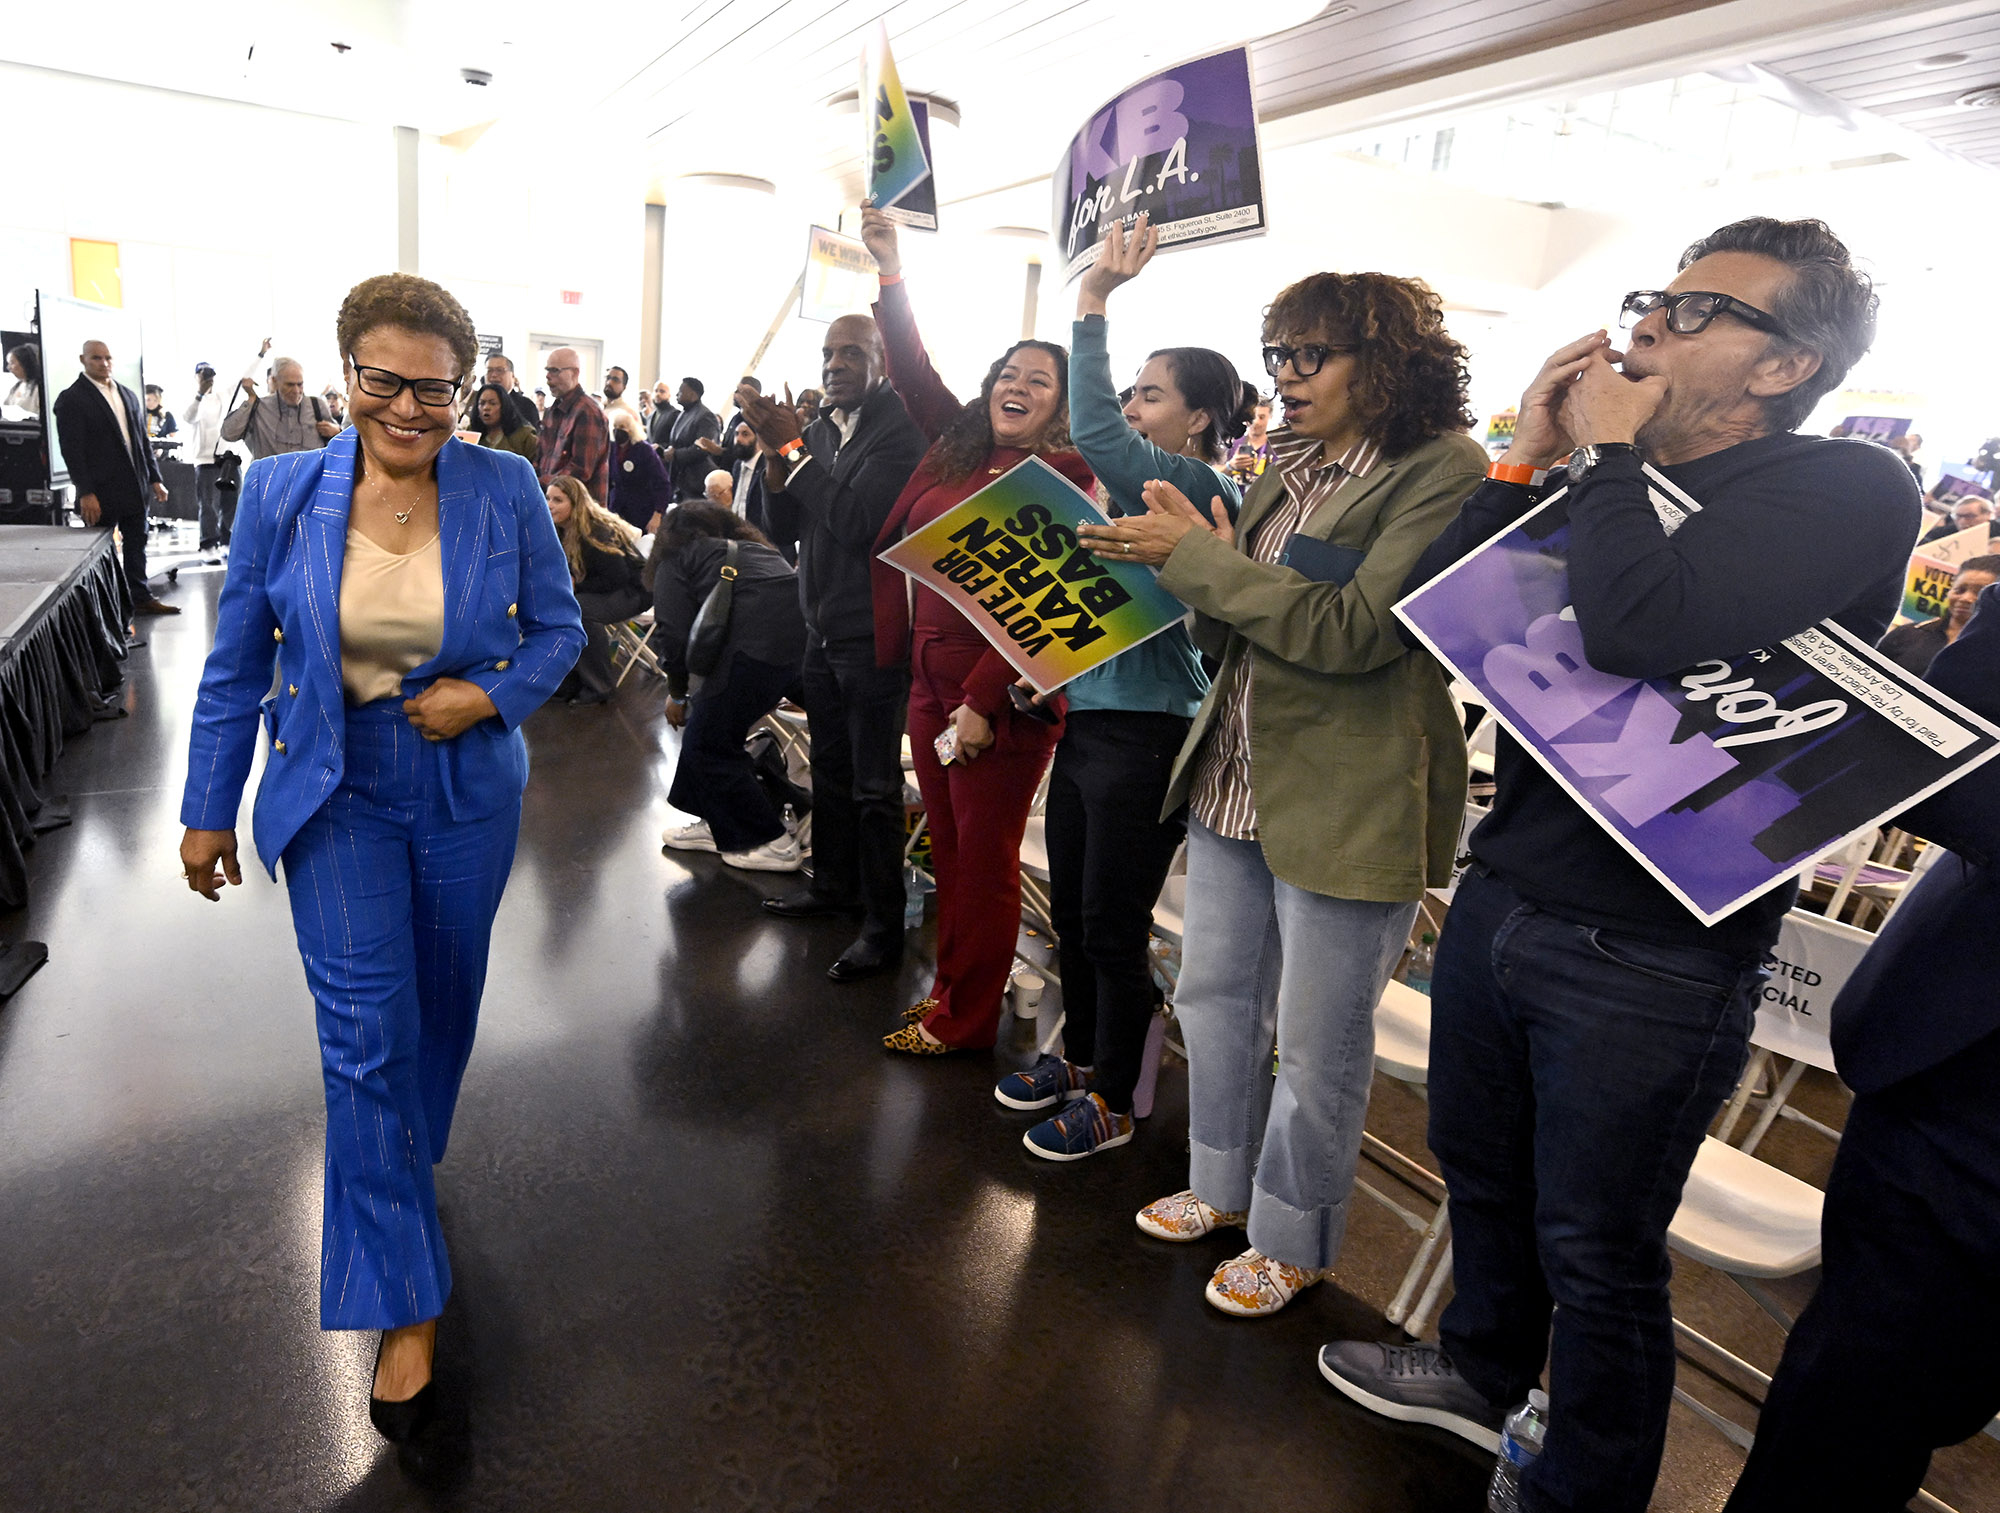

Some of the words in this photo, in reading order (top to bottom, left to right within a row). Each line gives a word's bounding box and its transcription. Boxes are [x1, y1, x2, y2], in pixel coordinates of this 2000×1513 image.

[1072, 79, 1190, 204] KB
[1067, 184, 1115, 259] for
[1120, 136, 1199, 203] L.A.
[1097, 216, 1125, 233] KARN
[1167, 225, 1218, 240] ethics.lacity.gov.
[1174, 218, 1202, 231] Figueroa
[1204, 216, 1215, 224] St.,
[1216, 213, 1233, 222] Suite
[1233, 208, 1251, 218] 2400
[818, 239, 837, 257] WE
[932, 547, 998, 596] FOR
[1004, 503, 1134, 619] BASS
[947, 516, 1107, 652] KAREN
[978, 585, 1055, 658] VOTE
[1802, 630, 1820, 643] 90
[1818, 640, 1837, 655] CA
[1812, 653, 1844, 678] Karen
[1838, 651, 1884, 687] Angeles,
[1681, 659, 1848, 748] for
[1840, 674, 1892, 709] Re-Elect
[1880, 682, 1904, 701] Los
[1483, 613, 1740, 829] KB
[1887, 705, 1904, 720] by
[1899, 712, 1918, 730] for
[1918, 726, 1946, 748] Paid
[1762, 960, 1822, 986] CTED
[1763, 986, 1812, 1016] CIAL
